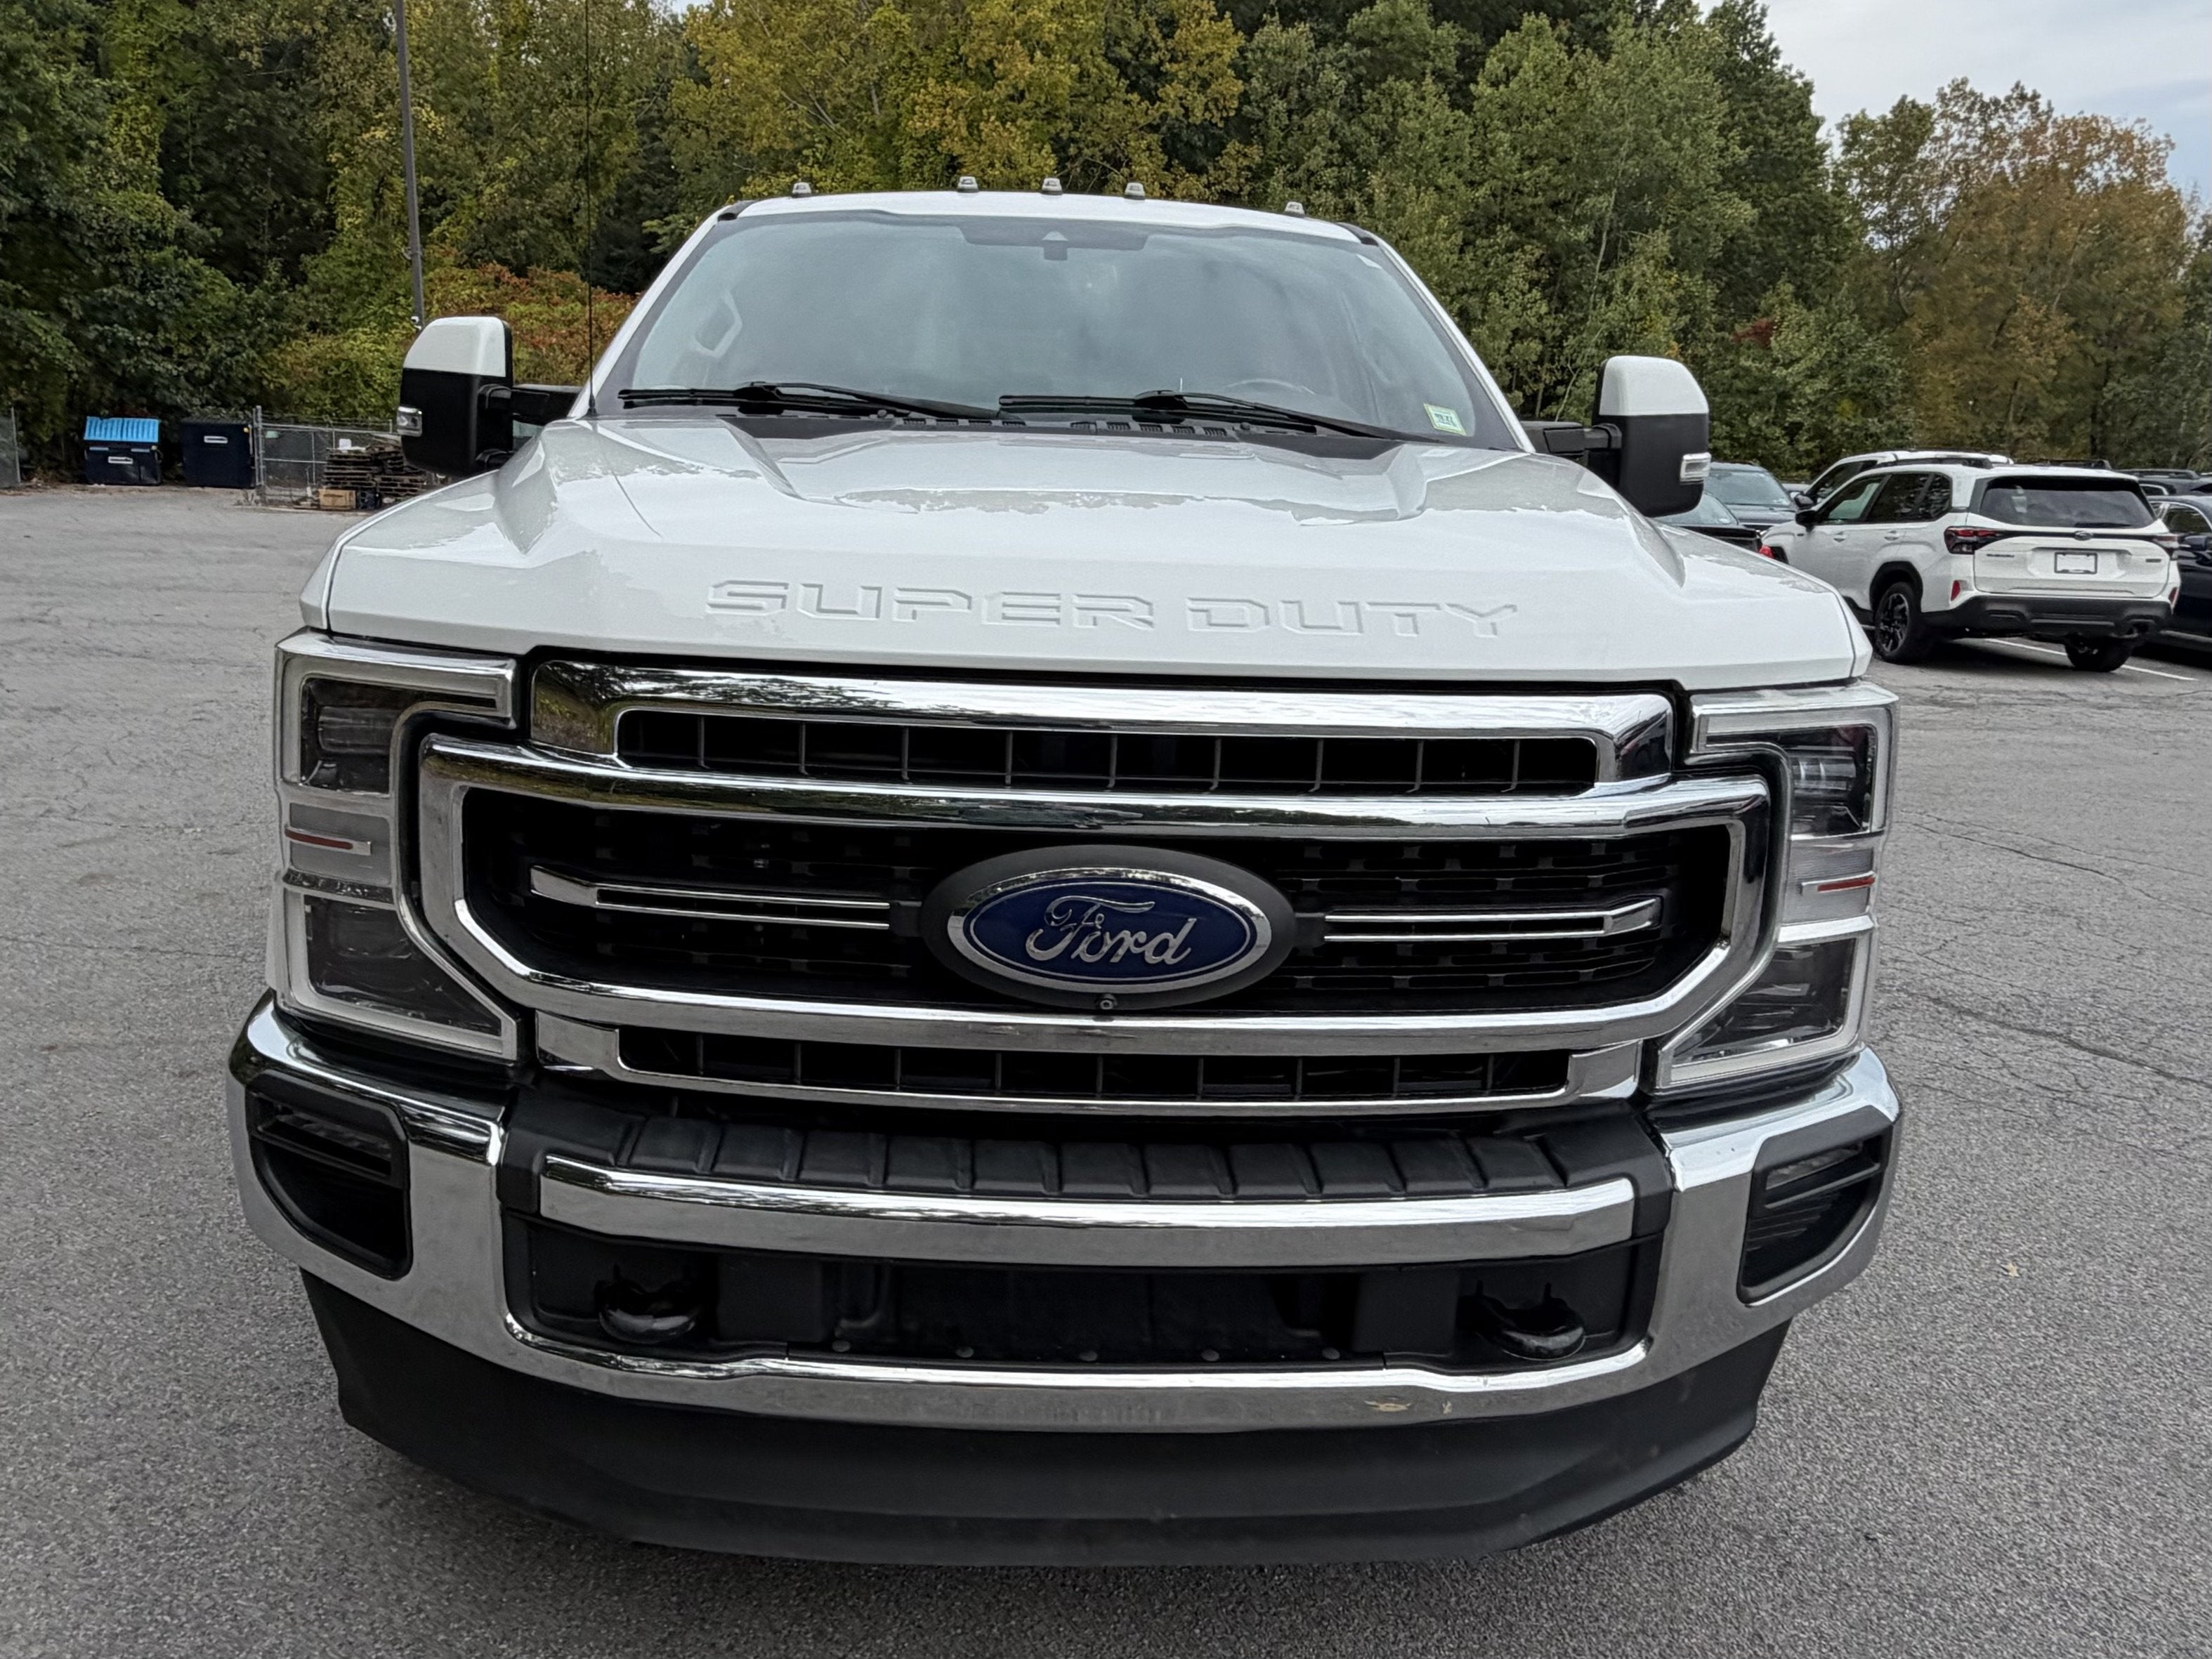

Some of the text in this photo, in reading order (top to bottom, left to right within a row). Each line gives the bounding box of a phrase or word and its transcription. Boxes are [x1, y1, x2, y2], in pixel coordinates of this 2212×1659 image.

[706, 579, 1519, 638] SUPER DUTY
[1026, 896, 1197, 964] Ford
